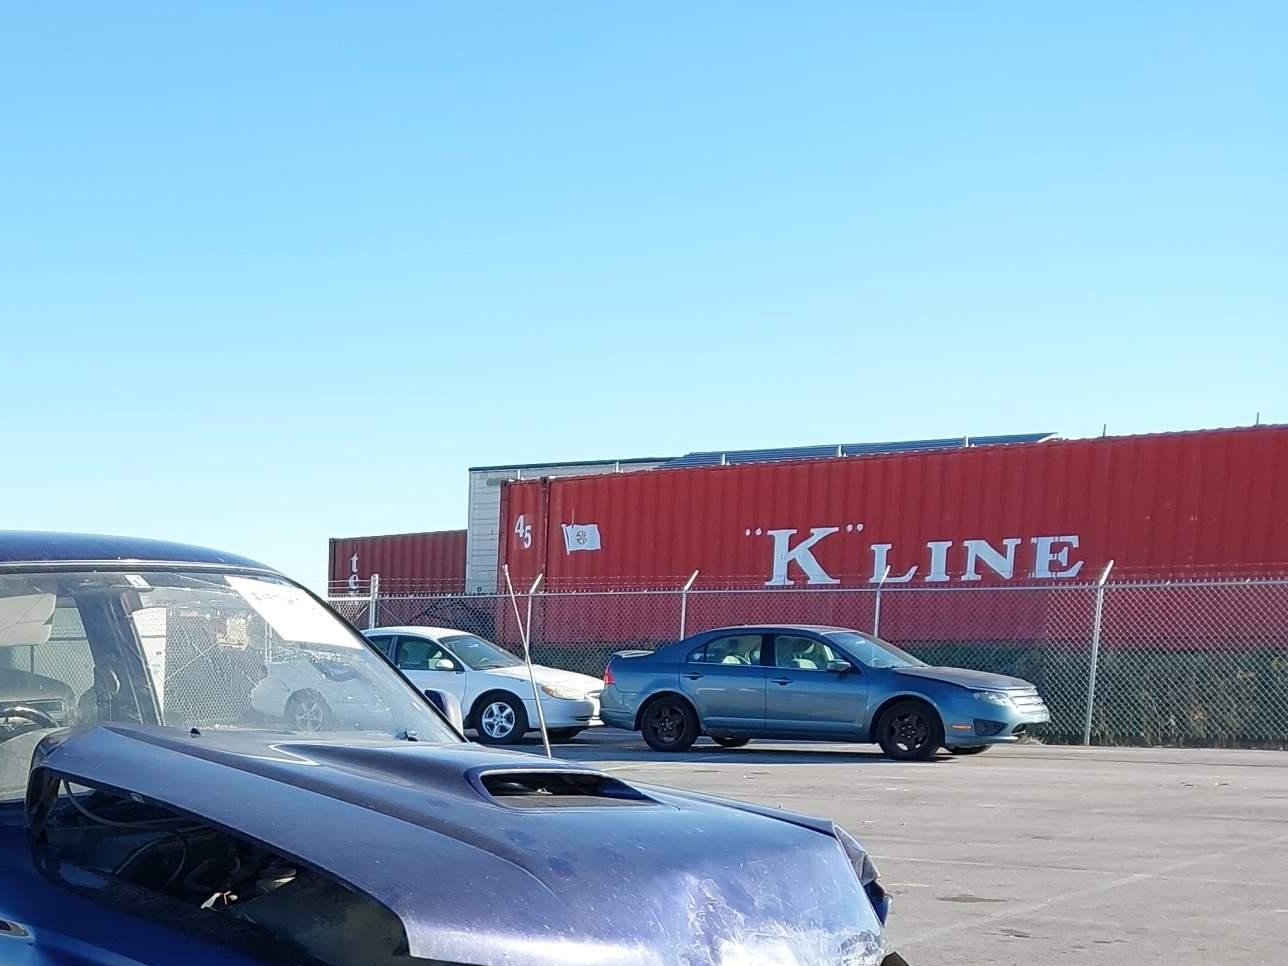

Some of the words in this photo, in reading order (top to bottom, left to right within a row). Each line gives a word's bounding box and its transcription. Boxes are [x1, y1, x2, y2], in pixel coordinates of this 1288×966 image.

[514, 514, 533, 549] 45
[349, 552, 360, 596] te
[868, 535, 1085, 584] LINE
